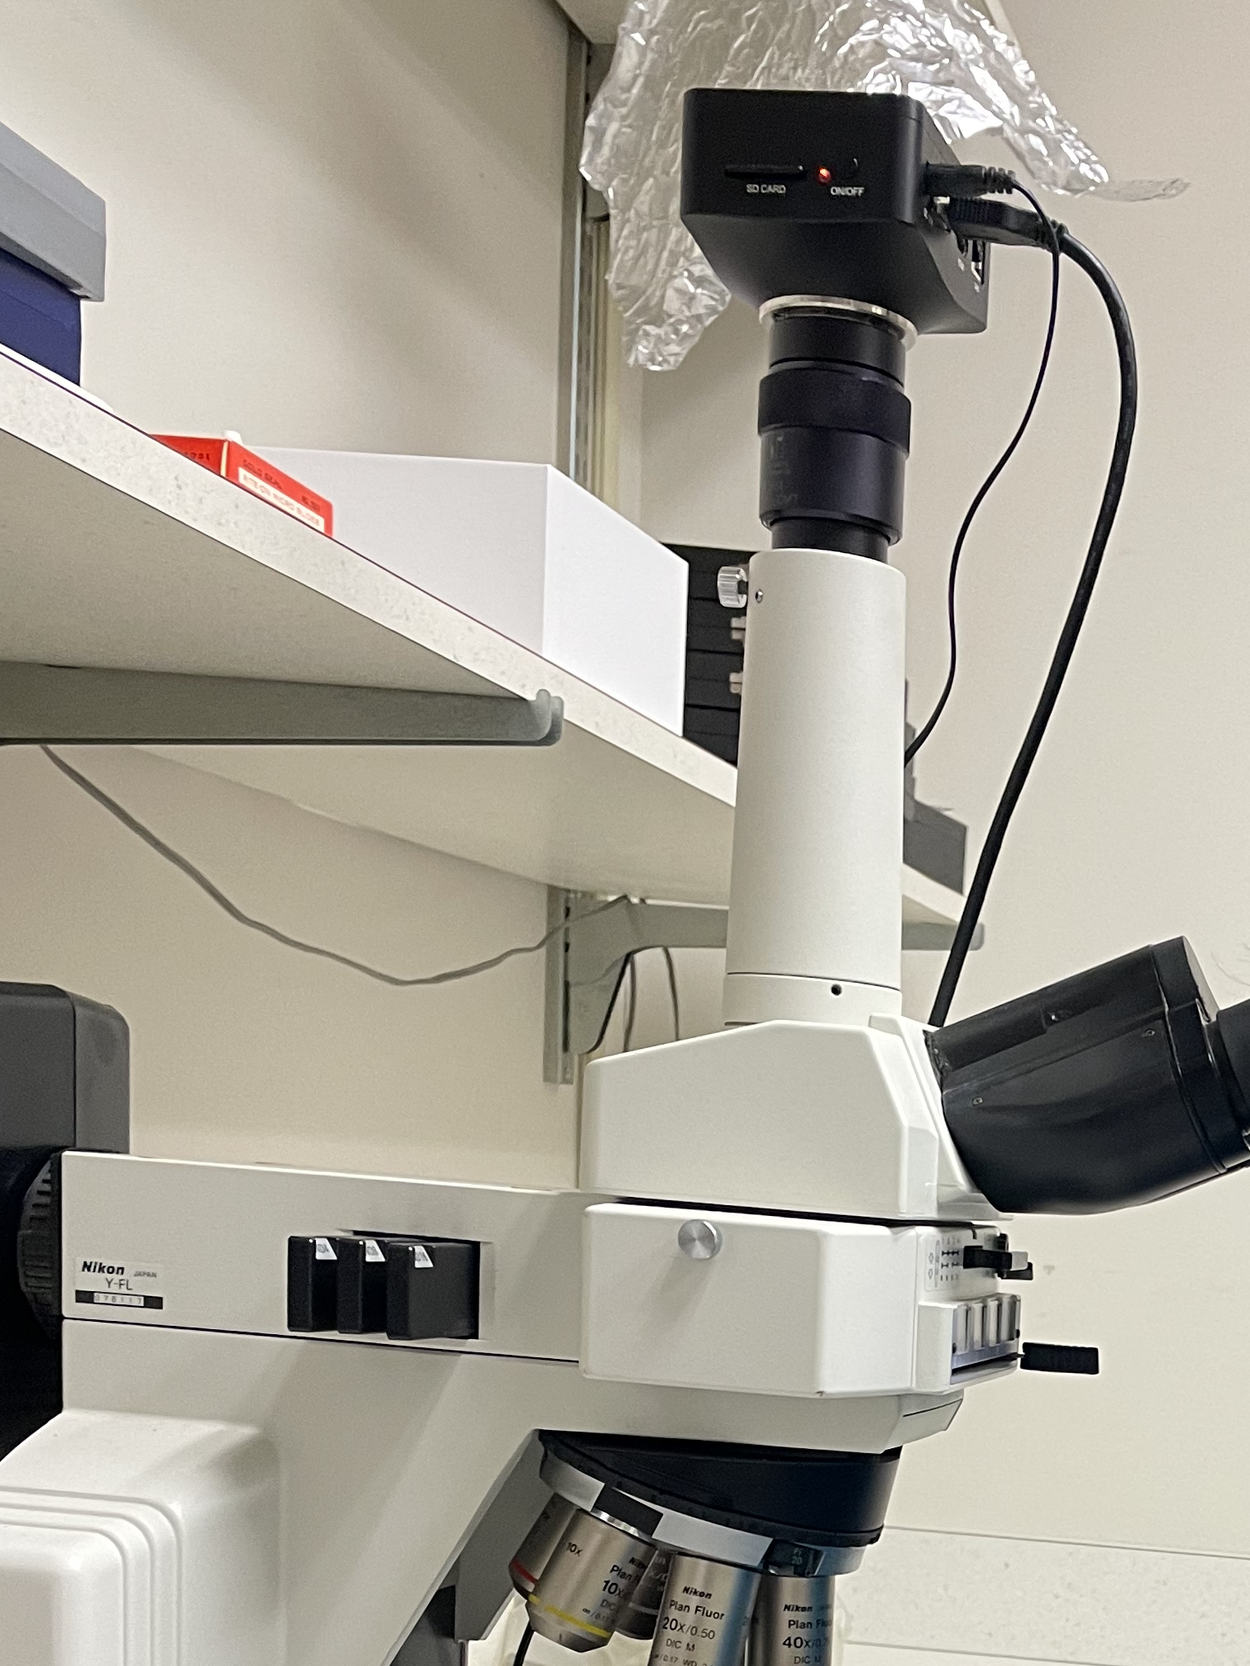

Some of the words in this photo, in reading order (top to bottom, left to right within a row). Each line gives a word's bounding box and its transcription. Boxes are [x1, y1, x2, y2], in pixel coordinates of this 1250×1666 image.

[745, 183, 759, 193] SD
[760, 184, 786, 194] CARD
[830, 186, 865, 196] ON/OFF
[81, 1260, 125, 1276] Nikon
[105, 1278, 133, 1291] Y-FL
[565, 1541, 583, 1557] 10x
[610, 1564, 632, 1581] Plan
[682, 1586, 712, 1600] Nikon
[668, 1599, 691, 1614] Plan
[694, 1604, 726, 1620] Fluor
[783, 1603, 813, 1613] Nikon
[662, 1616, 716, 1640] 20x/0.50
[788, 1619, 813, 1630] Plan
[665, 1637, 682, 1650] DIC
[794, 1655, 811, 1665] DIC
